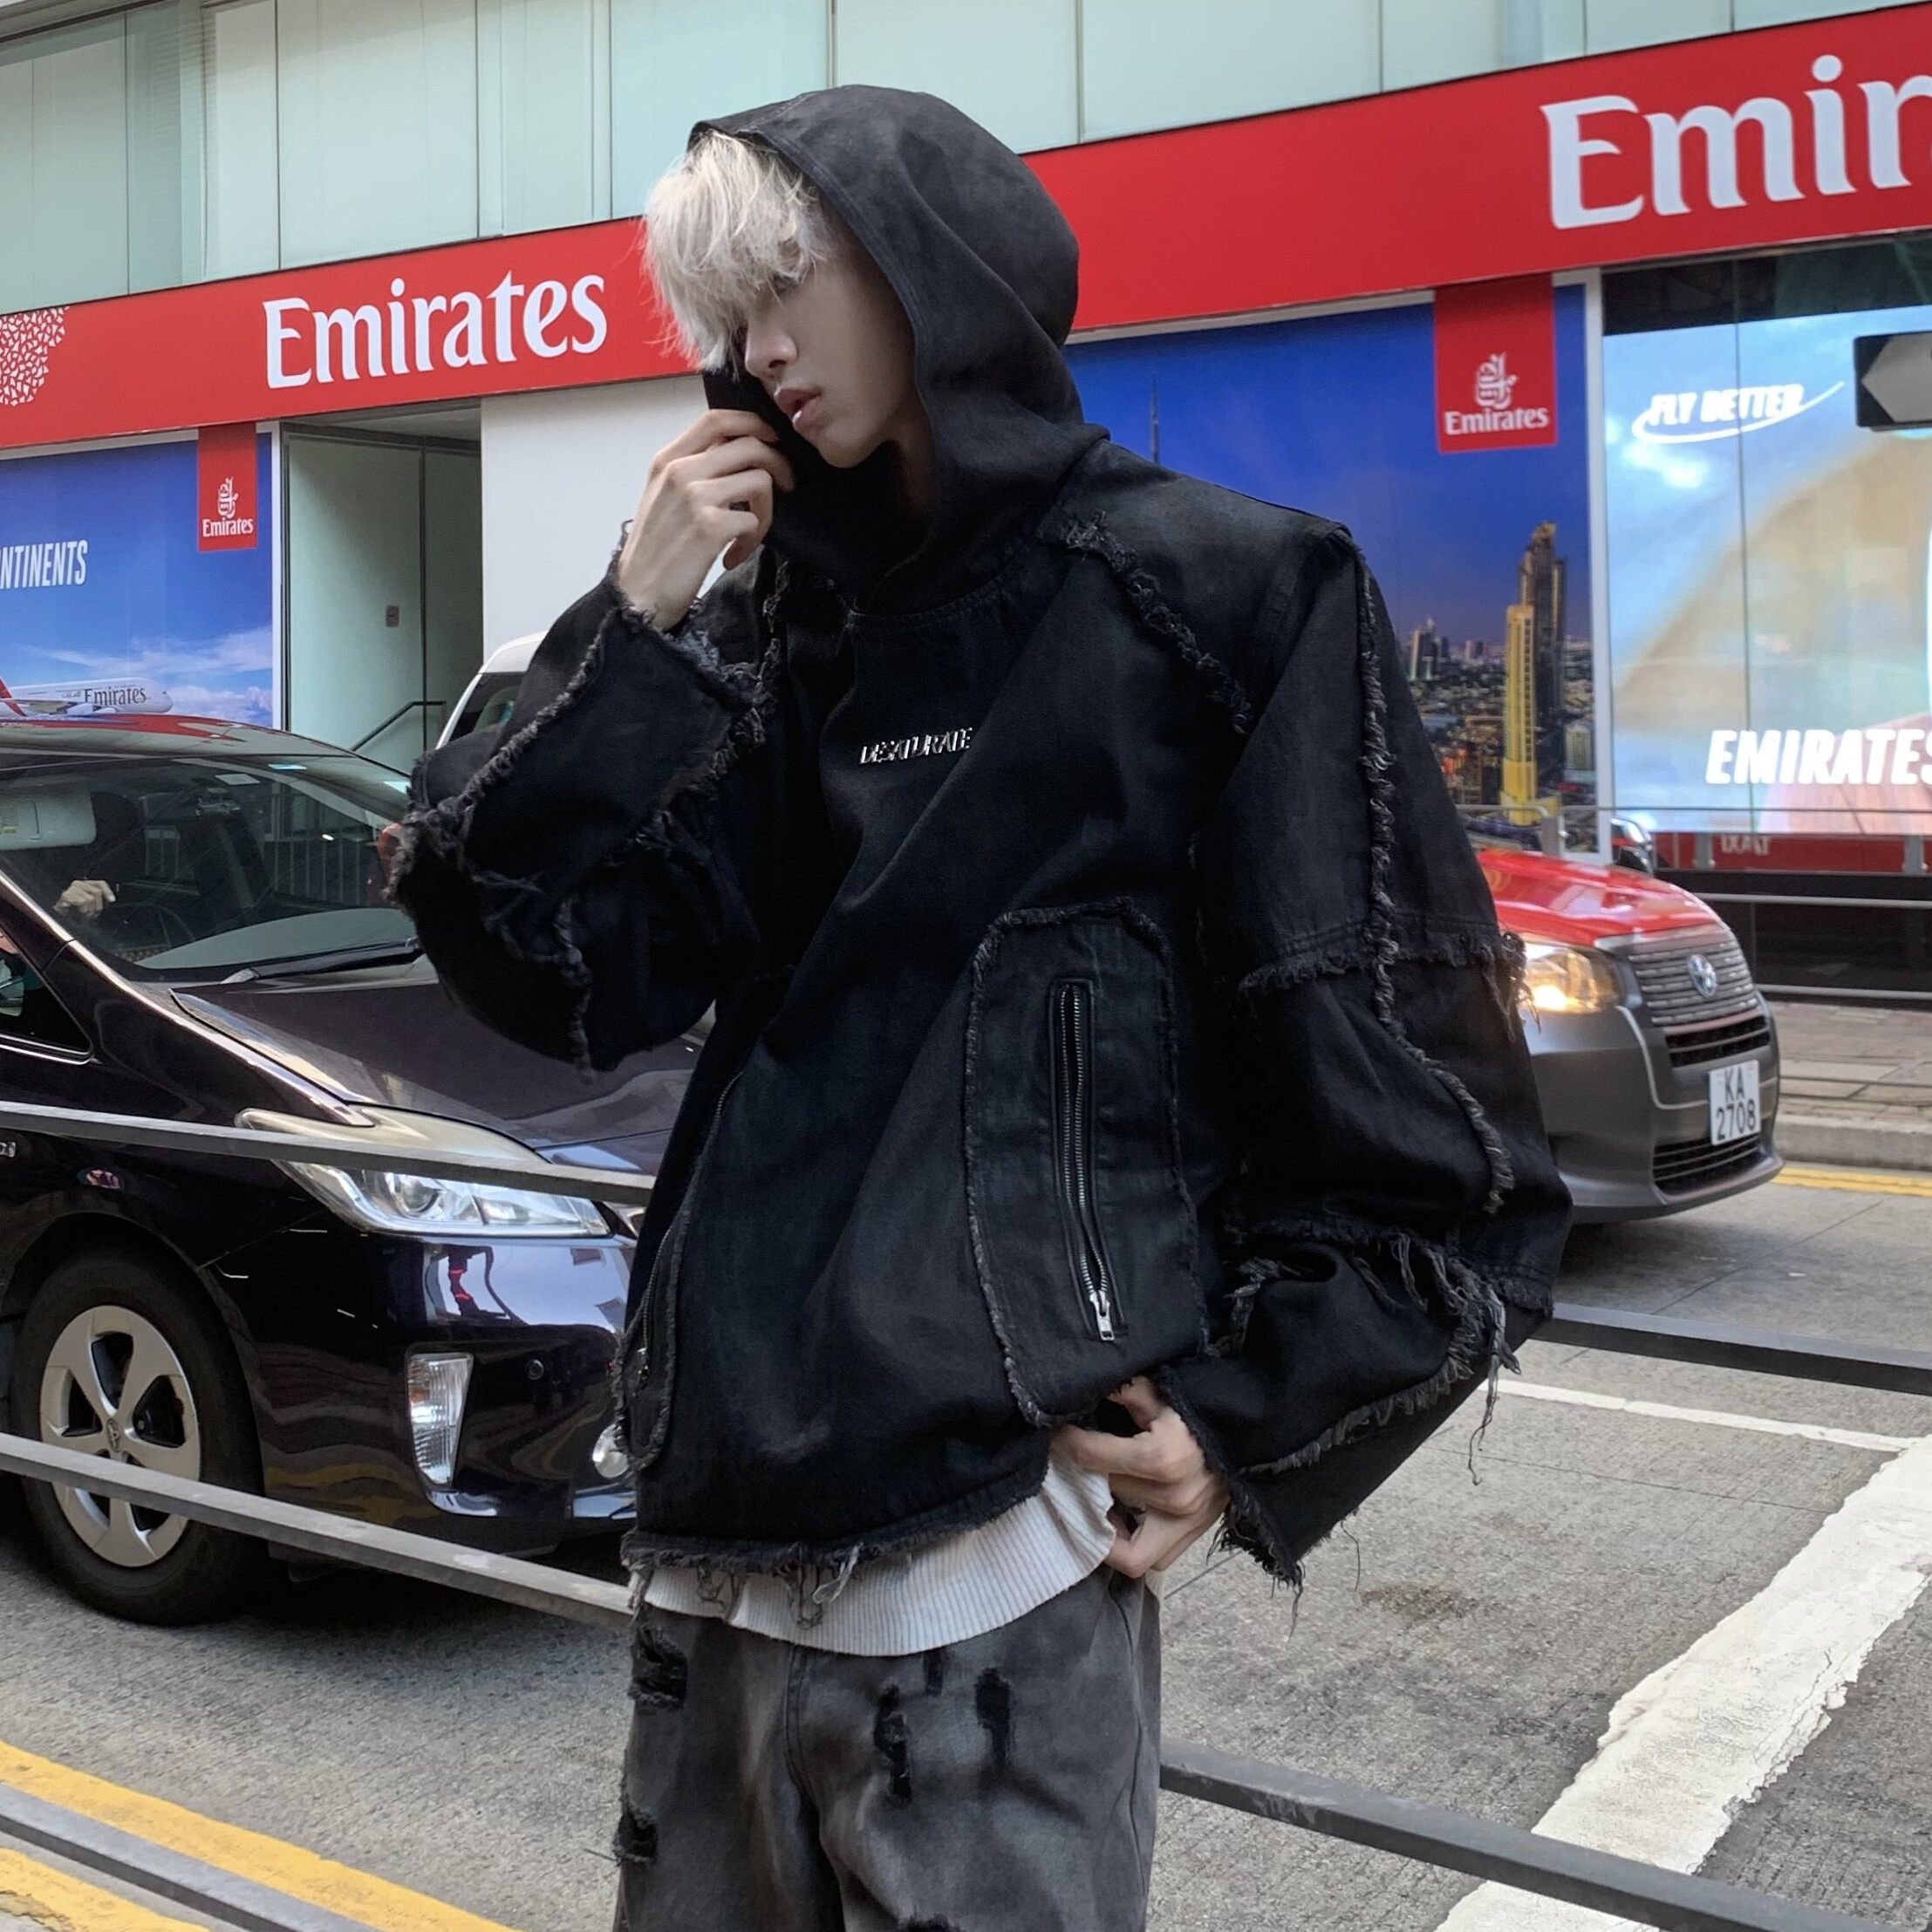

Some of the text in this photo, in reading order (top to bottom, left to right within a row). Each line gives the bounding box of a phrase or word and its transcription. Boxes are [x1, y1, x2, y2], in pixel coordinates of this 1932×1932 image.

[1539, 54, 1932, 229] Emir
[263, 270, 607, 388] Emirates
[1444, 406, 1550, 435] Emirates
[202, 517, 254, 537] Emirates
[0, 539, 88, 589] NTINENTS
[84, 686, 147, 706] Emirates
[1724, 1066, 1745, 1103] KA
[1716, 1098, 1757, 1141] 2708
